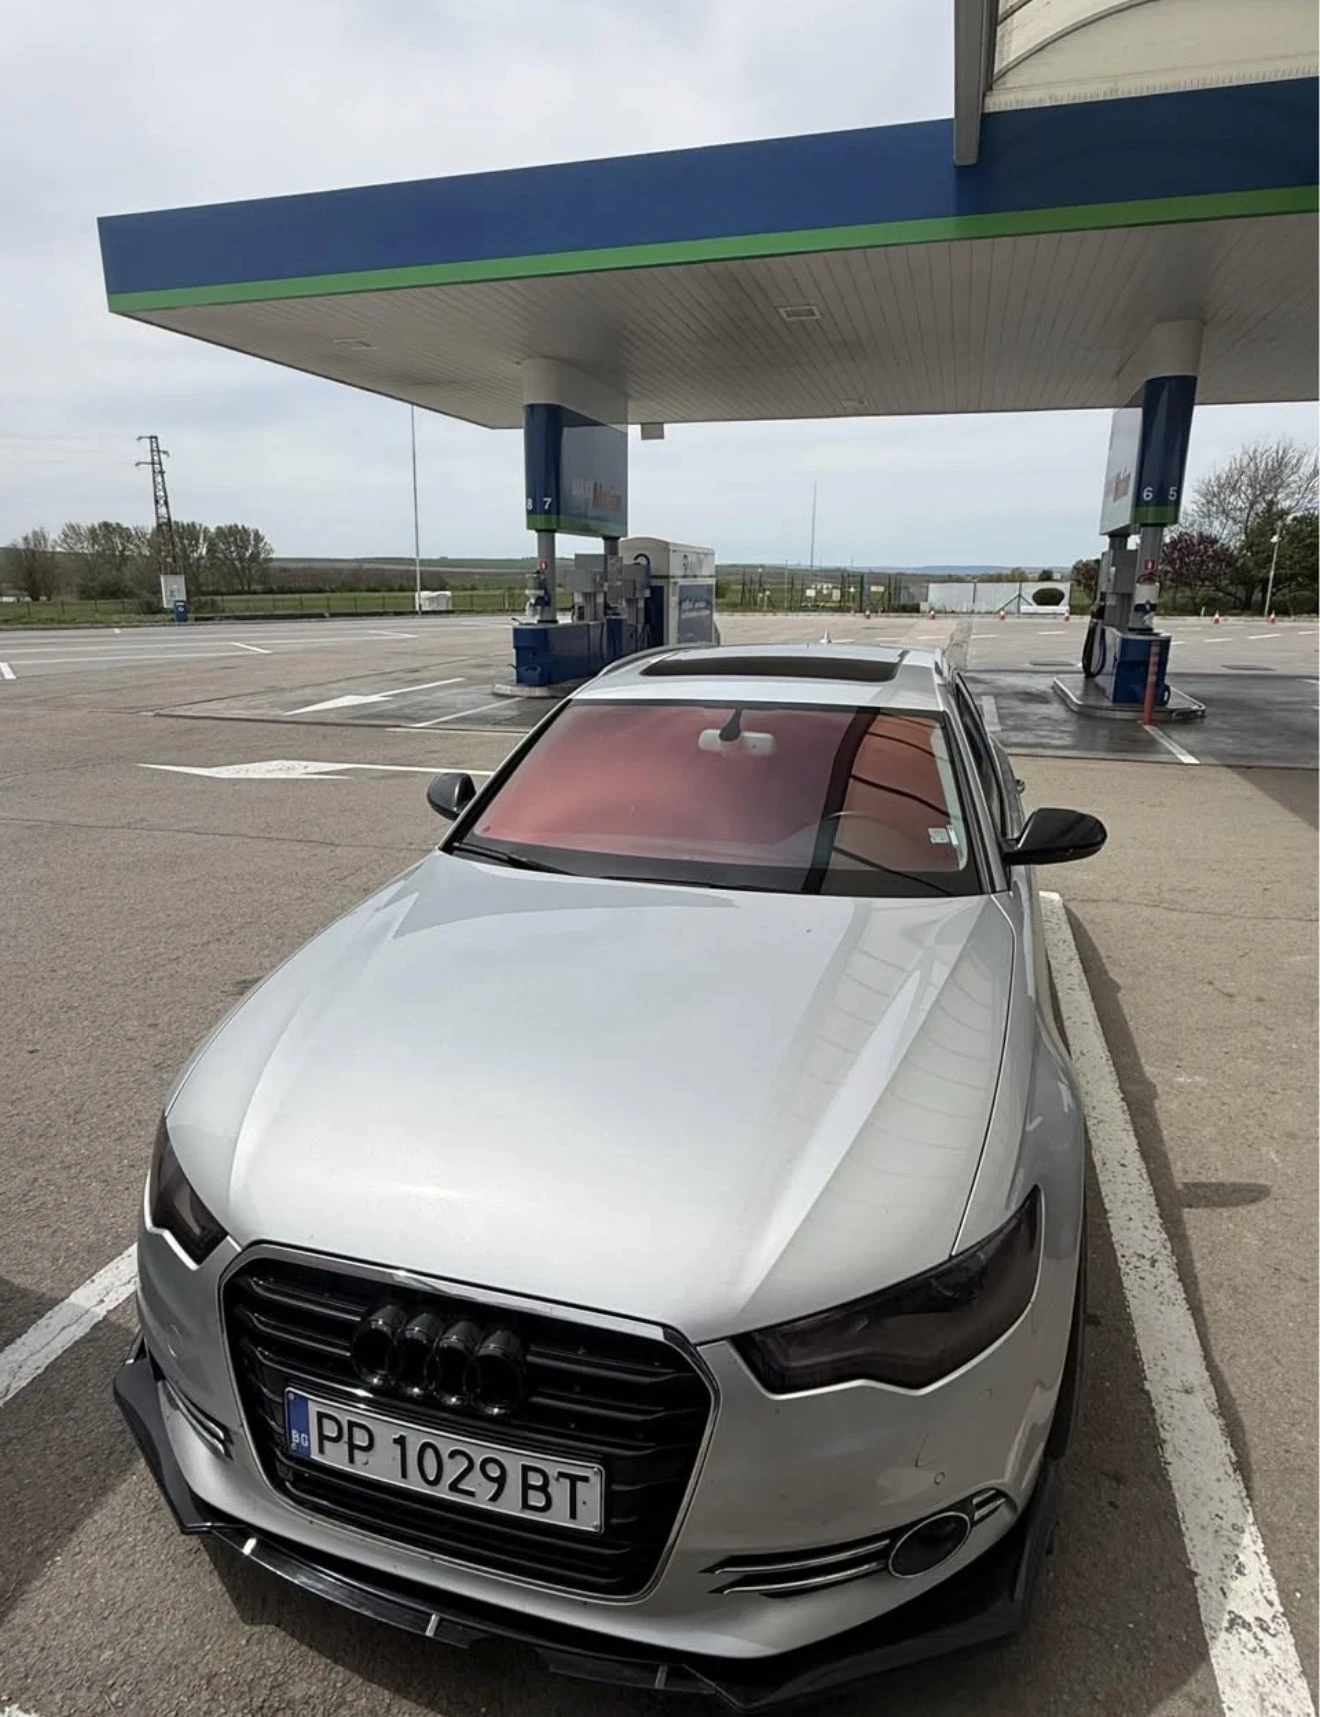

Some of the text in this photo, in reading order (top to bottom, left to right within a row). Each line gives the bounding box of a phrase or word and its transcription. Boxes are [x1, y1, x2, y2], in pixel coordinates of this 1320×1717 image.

[1143, 487, 1153, 500] 6
[1168, 487, 1177, 500] 5
[543, 498, 552, 510] 7
[291, 1409, 590, 1520] BG PP 1029 BT
